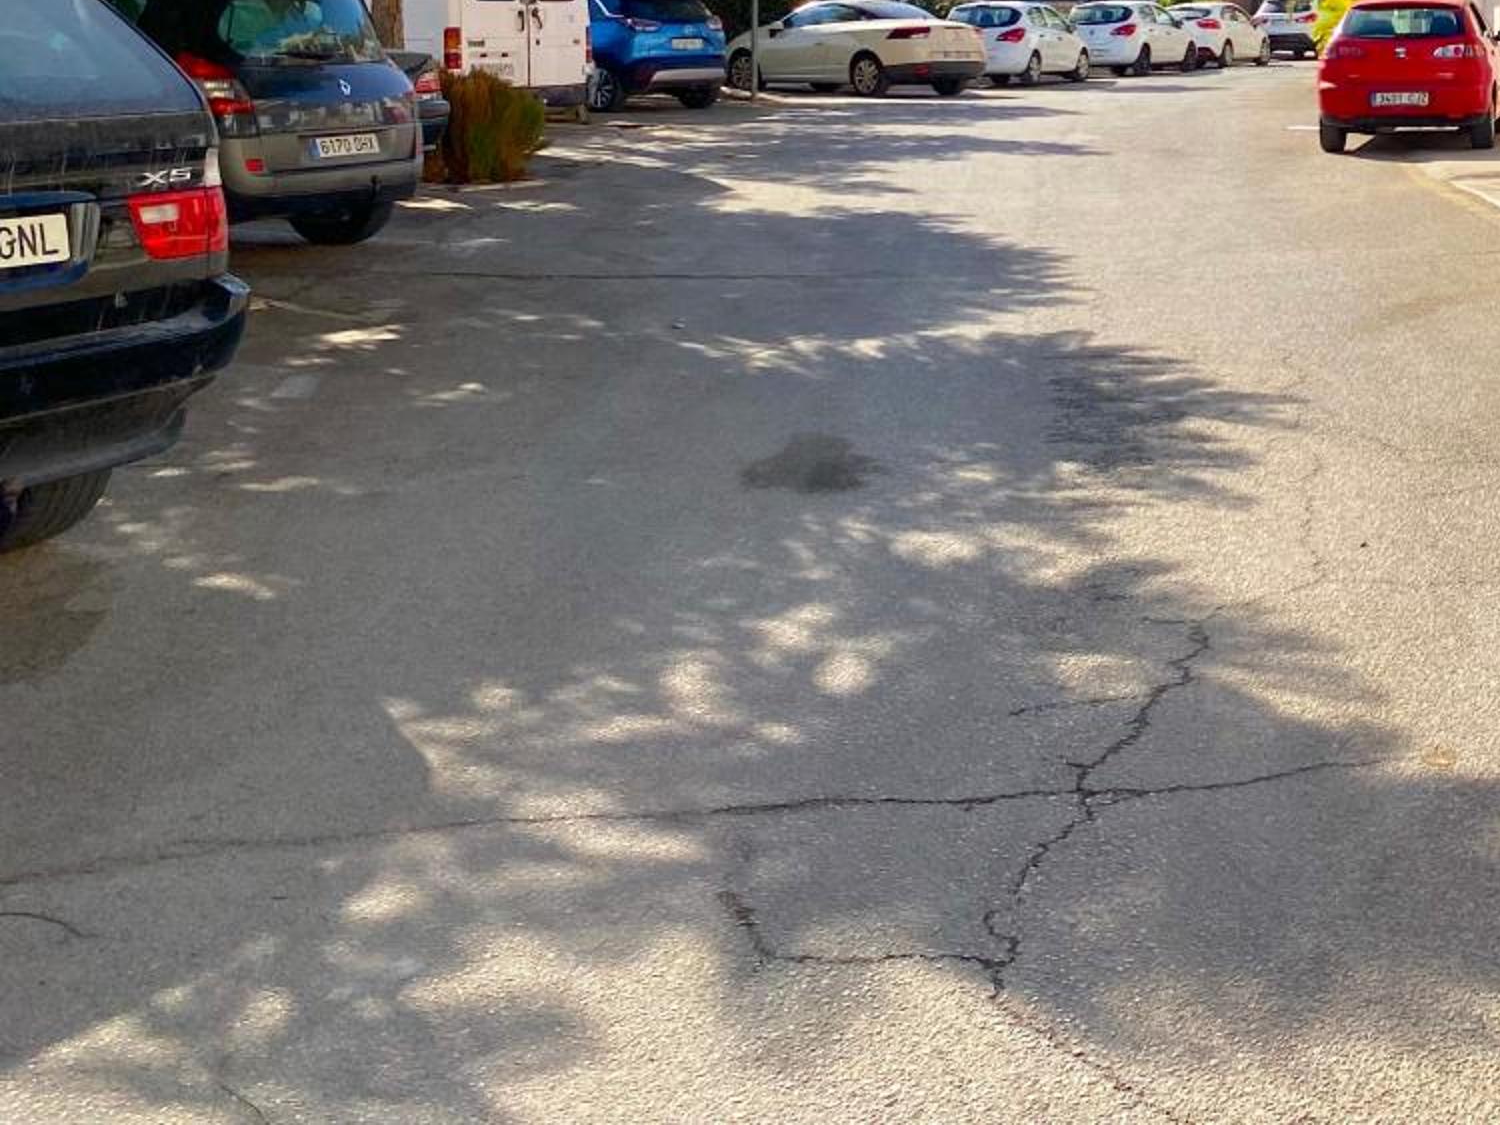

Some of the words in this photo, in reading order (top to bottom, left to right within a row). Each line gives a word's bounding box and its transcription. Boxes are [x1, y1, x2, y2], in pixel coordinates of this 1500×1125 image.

[320, 137, 351, 155] 6170
[140, 166, 192, 186] X5
[0, 223, 59, 260] GNL
